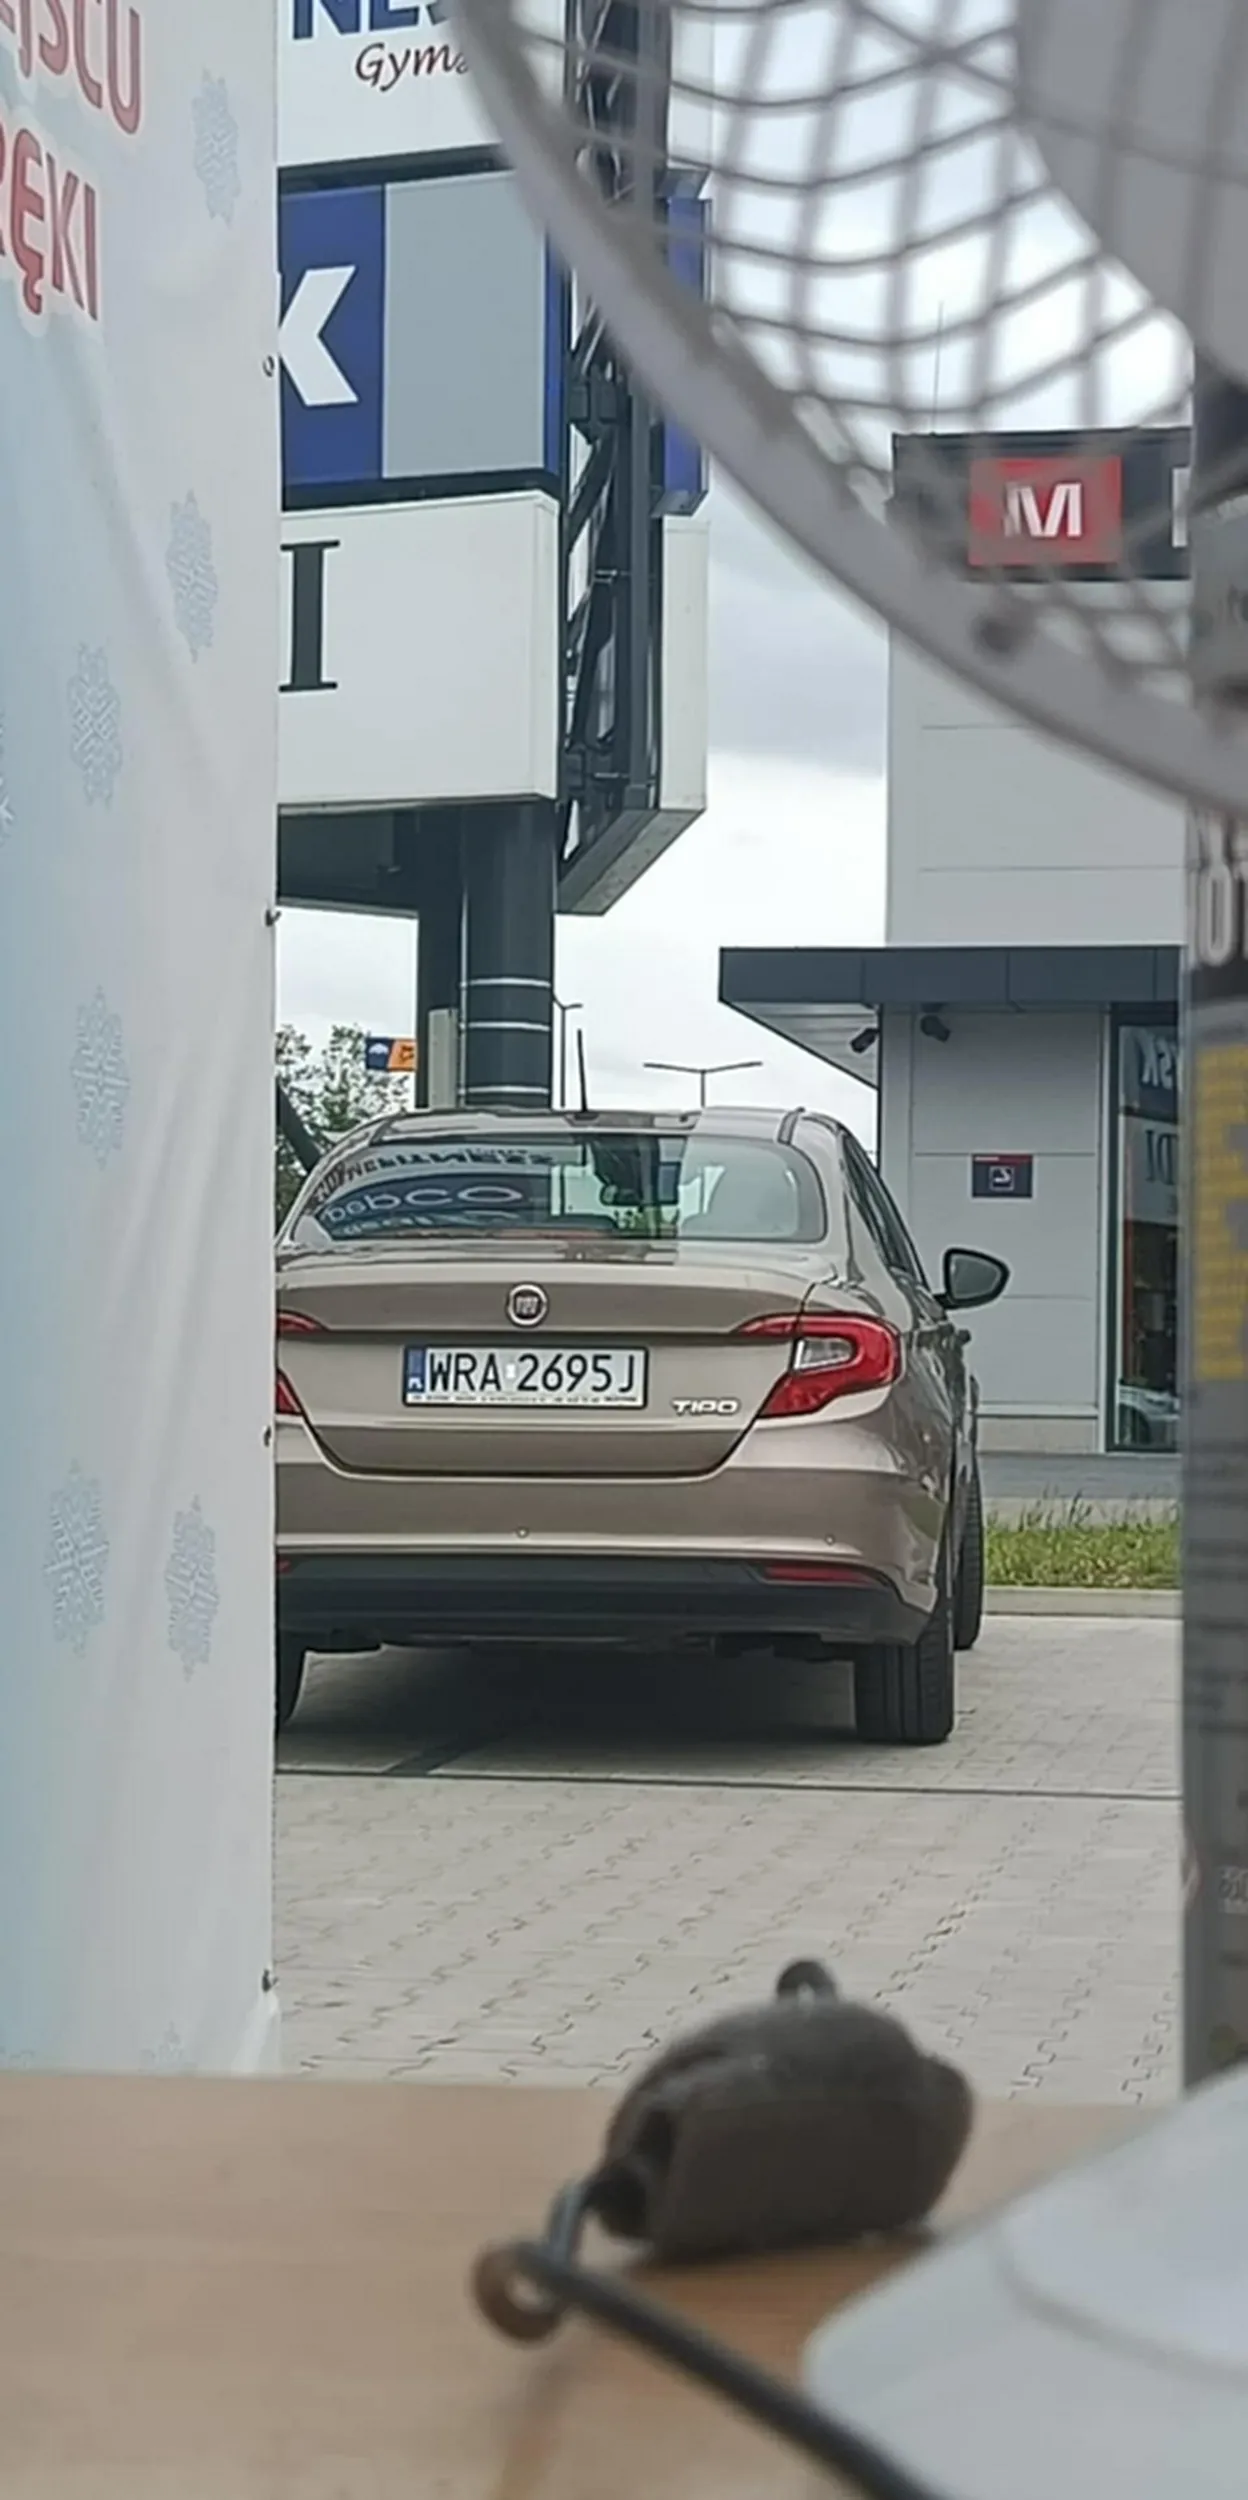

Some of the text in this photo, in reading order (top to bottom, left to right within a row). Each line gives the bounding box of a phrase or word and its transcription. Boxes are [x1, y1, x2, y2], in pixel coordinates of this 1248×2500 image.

[0, 123, 97, 321] ĘKI
[429, 1352, 635, 1393] WRA 2695J
[672, 1399, 739, 1414] TIPO
